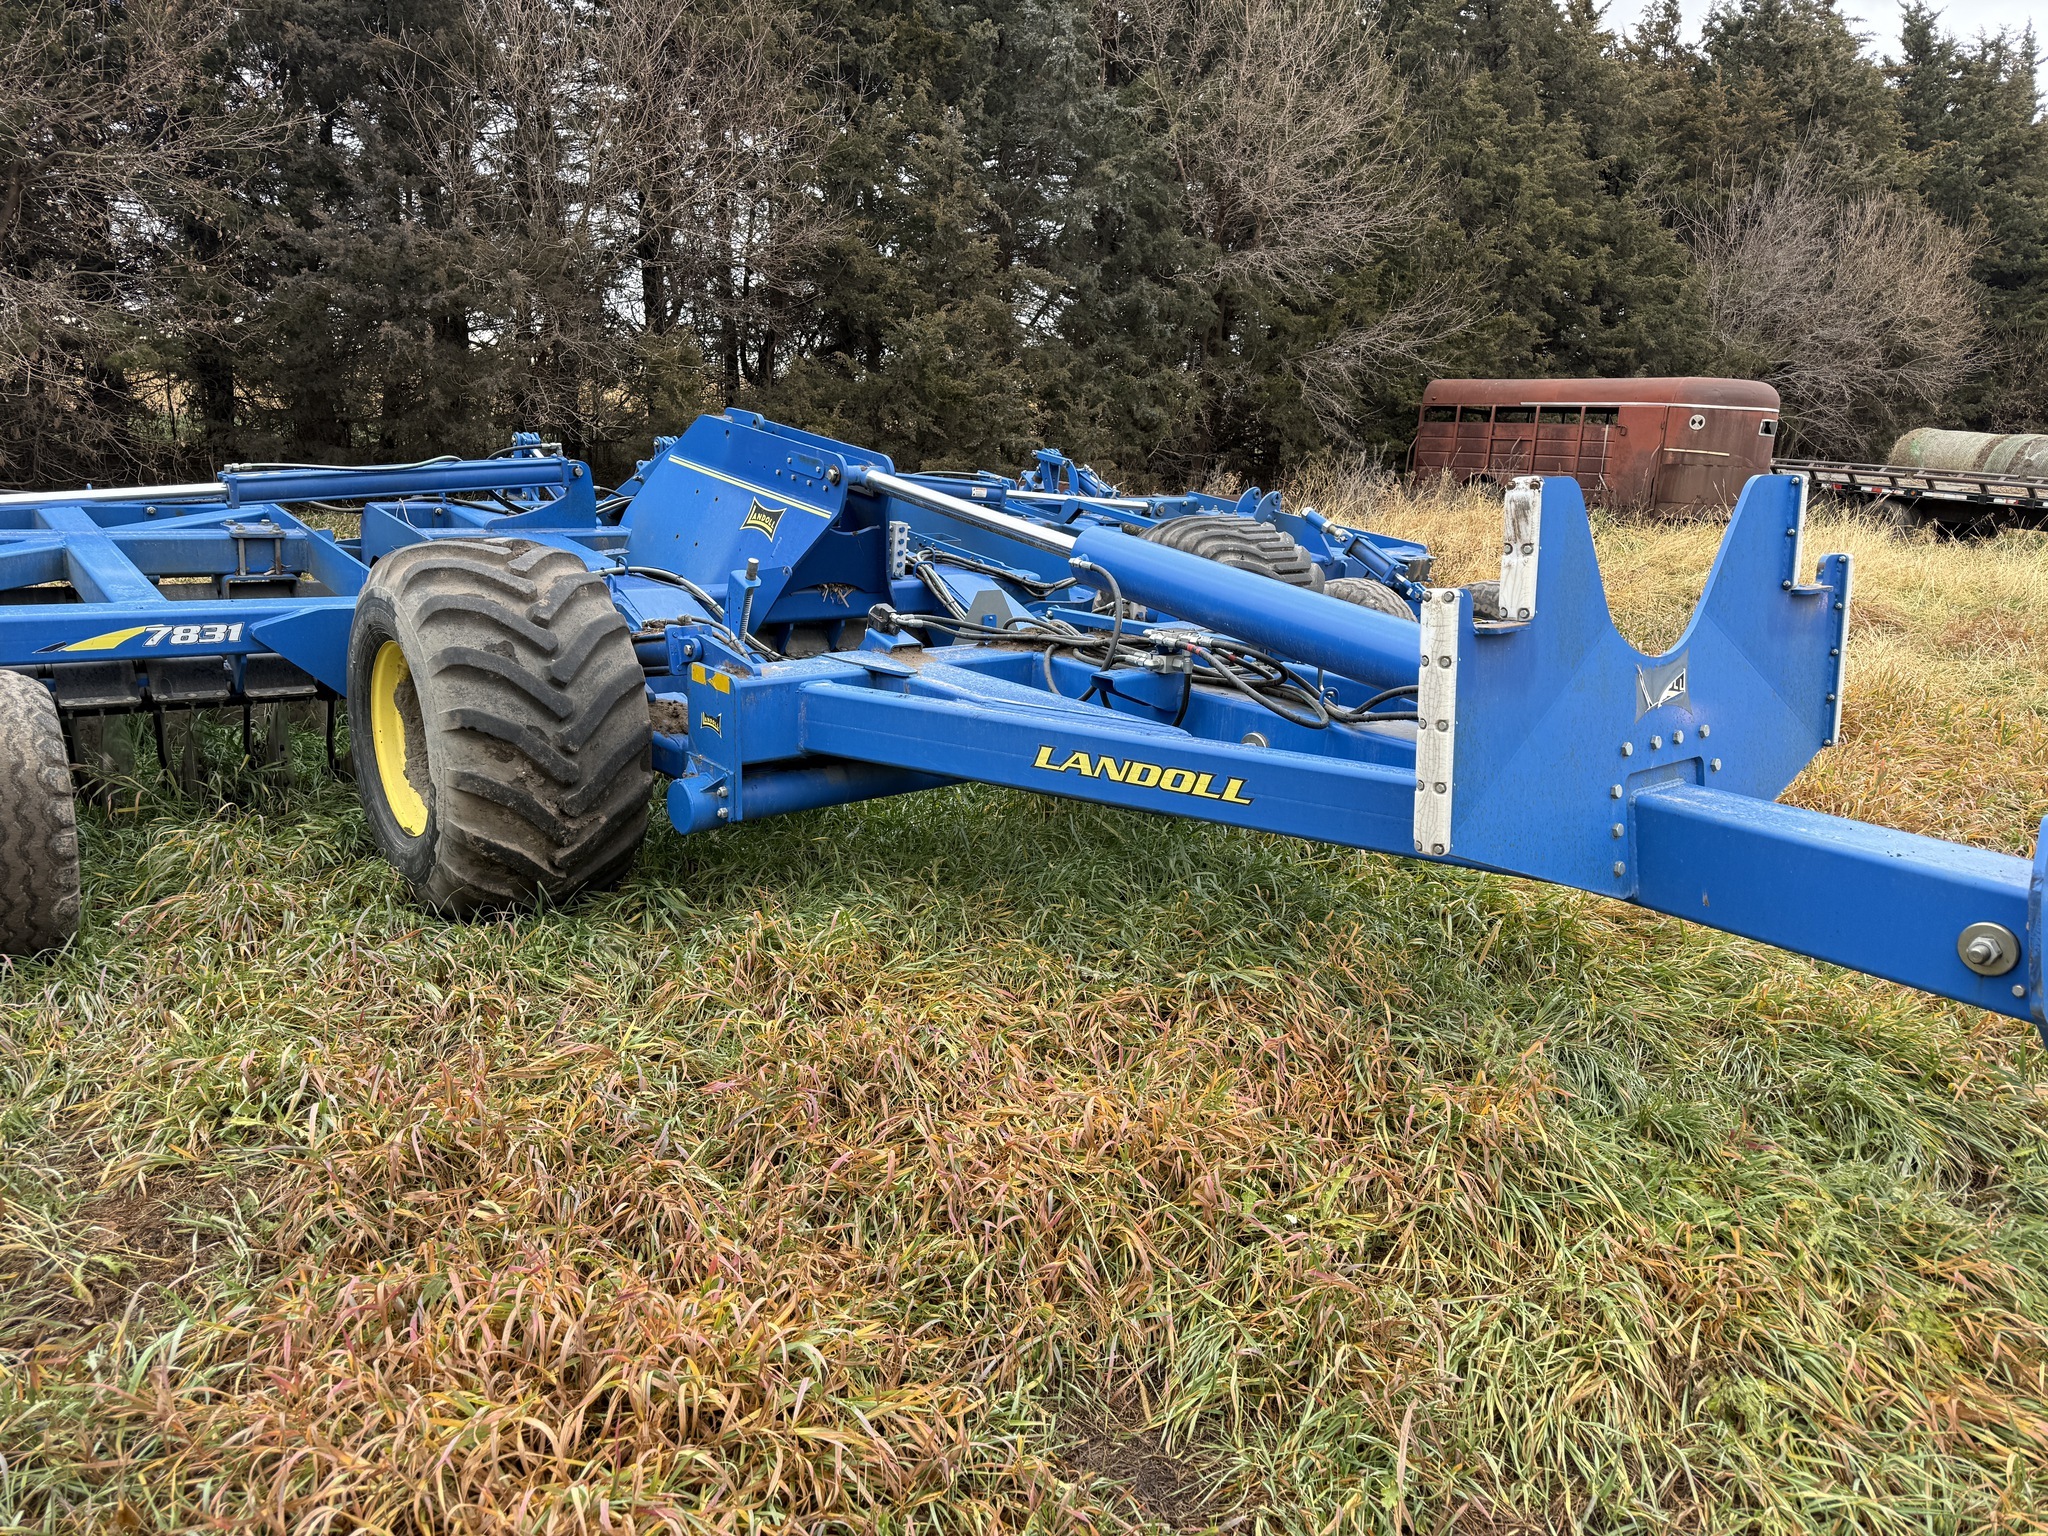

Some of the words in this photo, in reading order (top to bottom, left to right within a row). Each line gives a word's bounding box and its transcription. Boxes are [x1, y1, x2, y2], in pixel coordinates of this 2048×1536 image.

[746, 504, 776, 534] LANDOLL
[142, 622, 245, 647] 7831
[1031, 744, 1254, 806] LANDOLL
